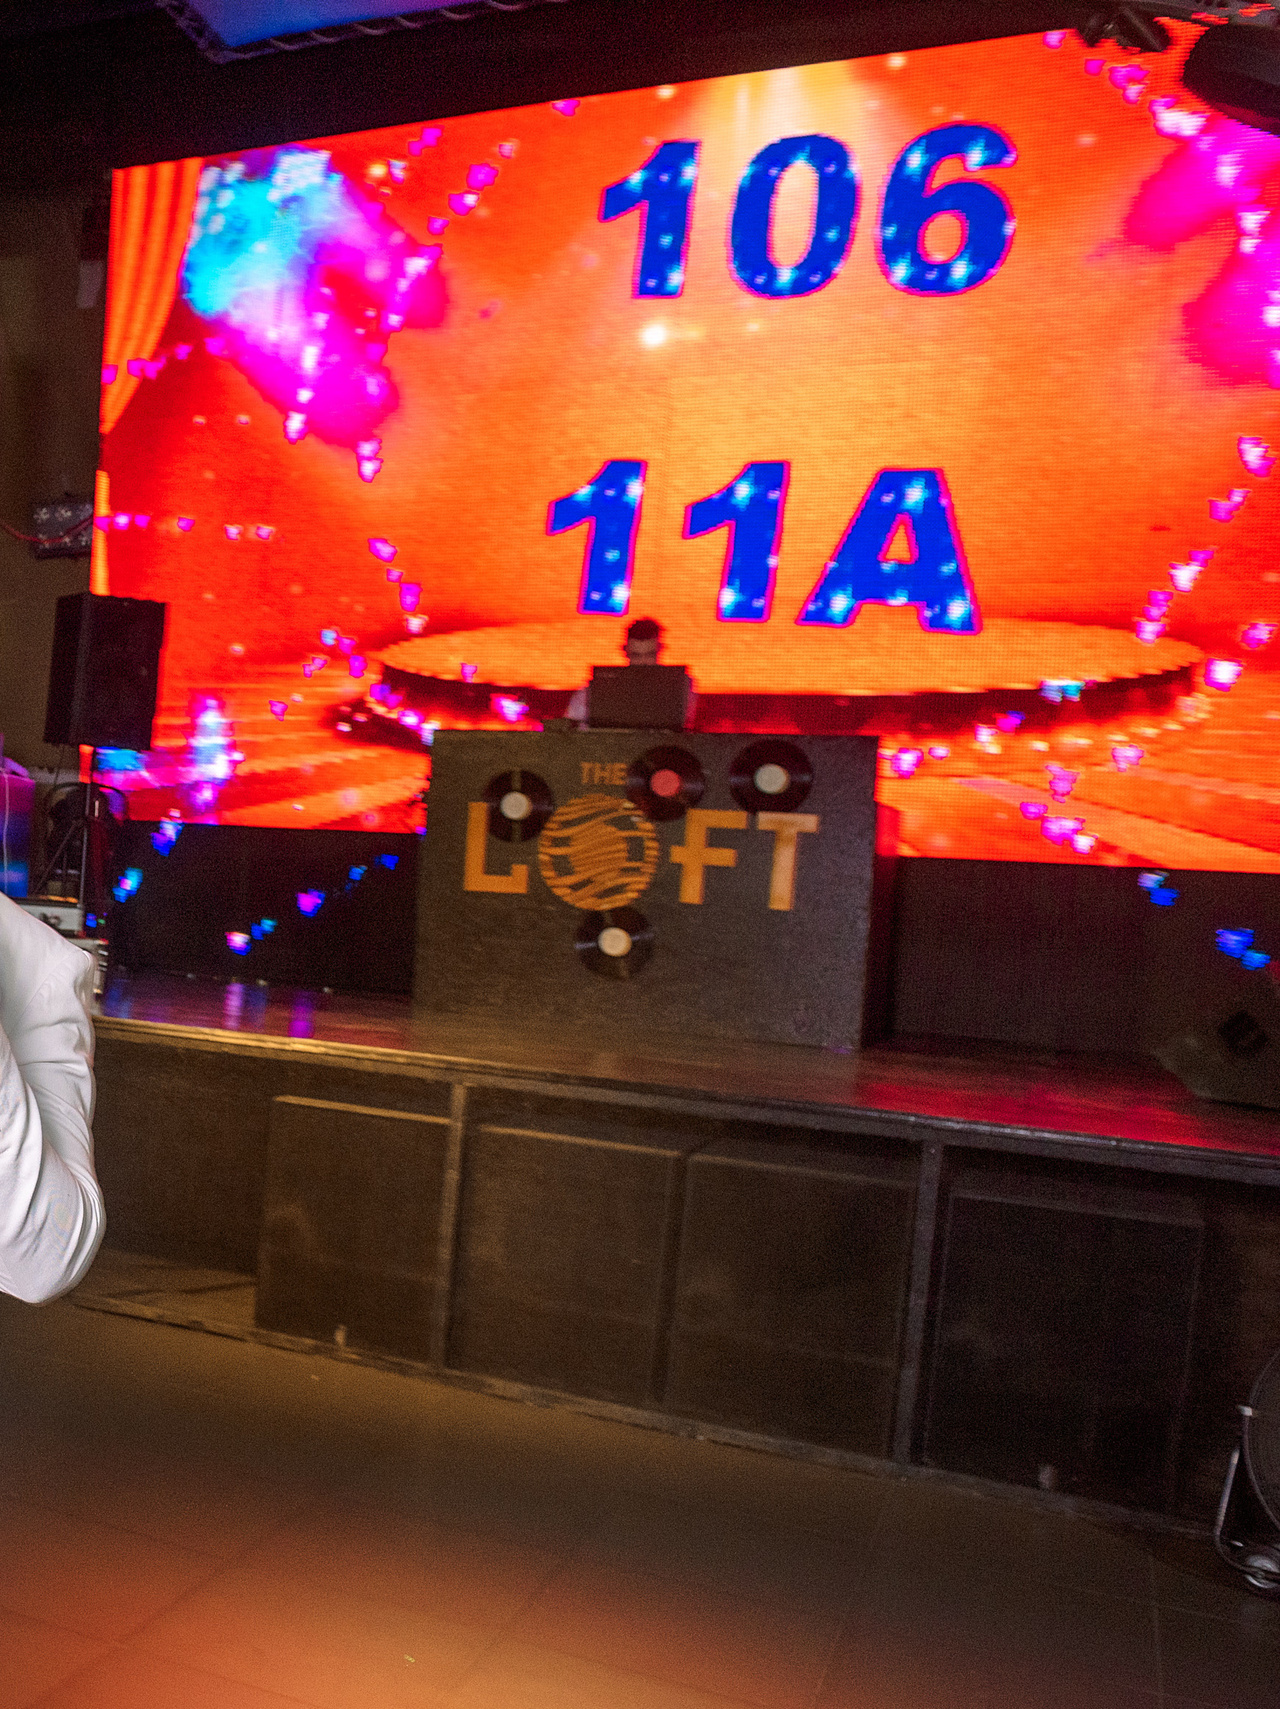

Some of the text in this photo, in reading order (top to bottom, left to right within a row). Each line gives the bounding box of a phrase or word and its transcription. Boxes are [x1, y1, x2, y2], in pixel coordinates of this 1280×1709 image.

[597, 121, 1018, 299] 106
[546, 459, 983, 635] 11A
[580, 762, 627, 785] THE
[463, 795, 819, 911] LOFT
